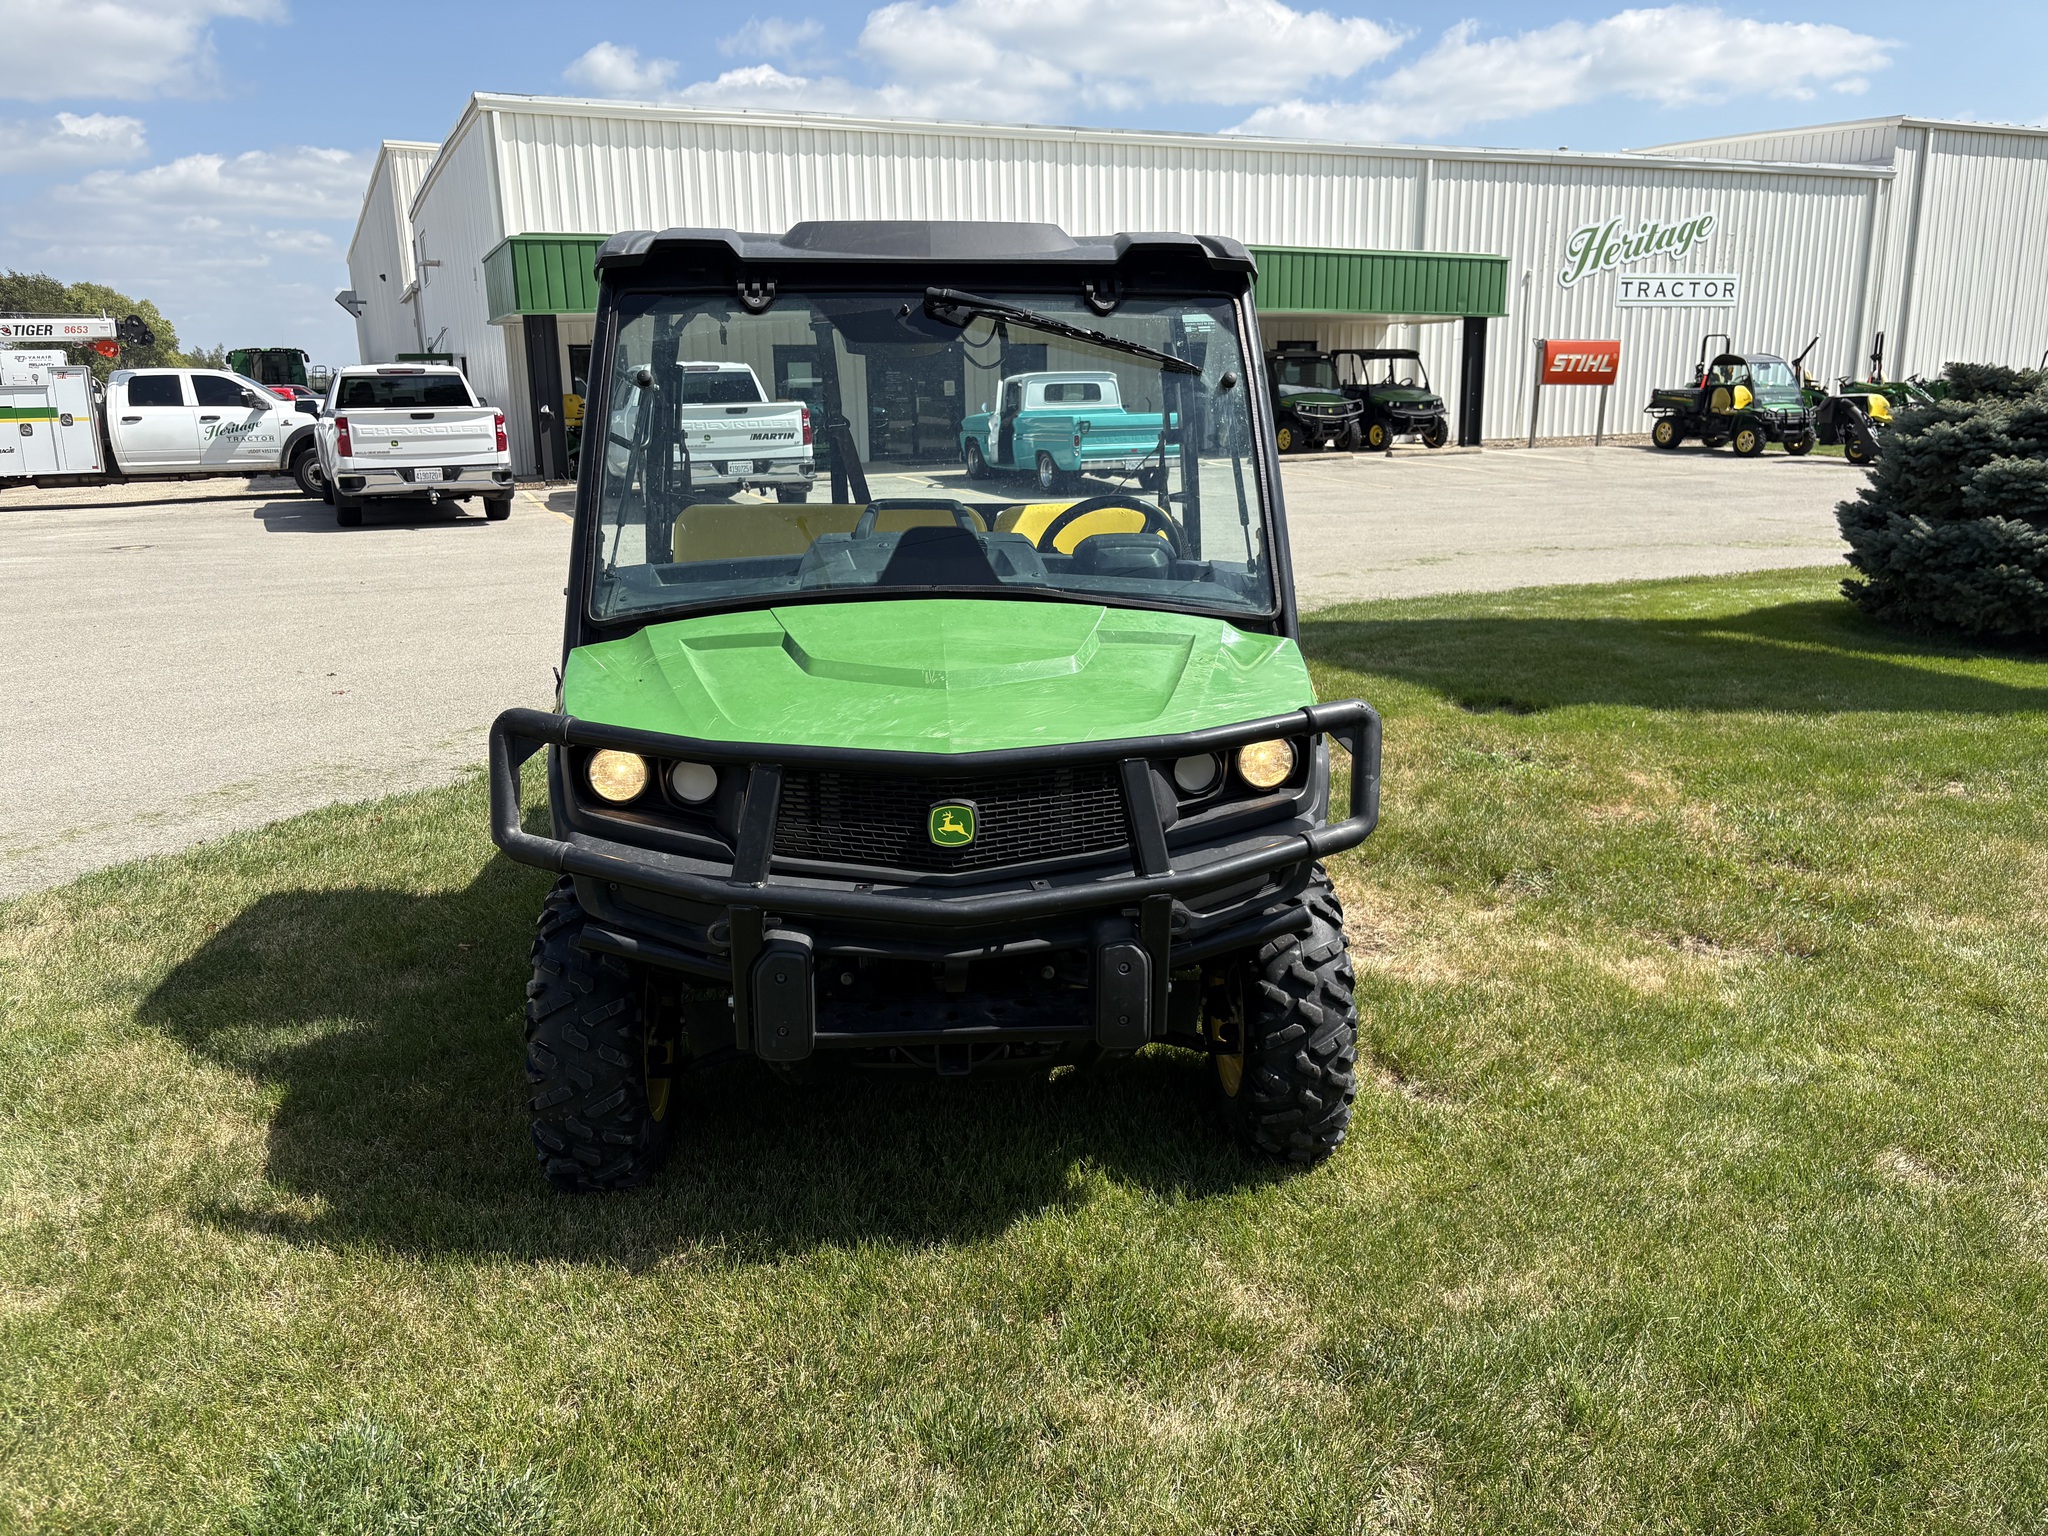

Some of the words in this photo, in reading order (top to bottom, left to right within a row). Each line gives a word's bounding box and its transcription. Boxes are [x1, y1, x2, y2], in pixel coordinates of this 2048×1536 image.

[1562, 215, 1714, 283] Heritage
[1620, 281, 1736, 298] TRACTOR
[13, 324, 53, 336] TIGER
[64, 325, 89, 334] 8653
[1549, 353, 1614, 373] STIHL
[203, 420, 263, 441] Heritage
[360, 425, 487, 437] CHEVROLET
[752, 432, 795, 441] MARTIN
